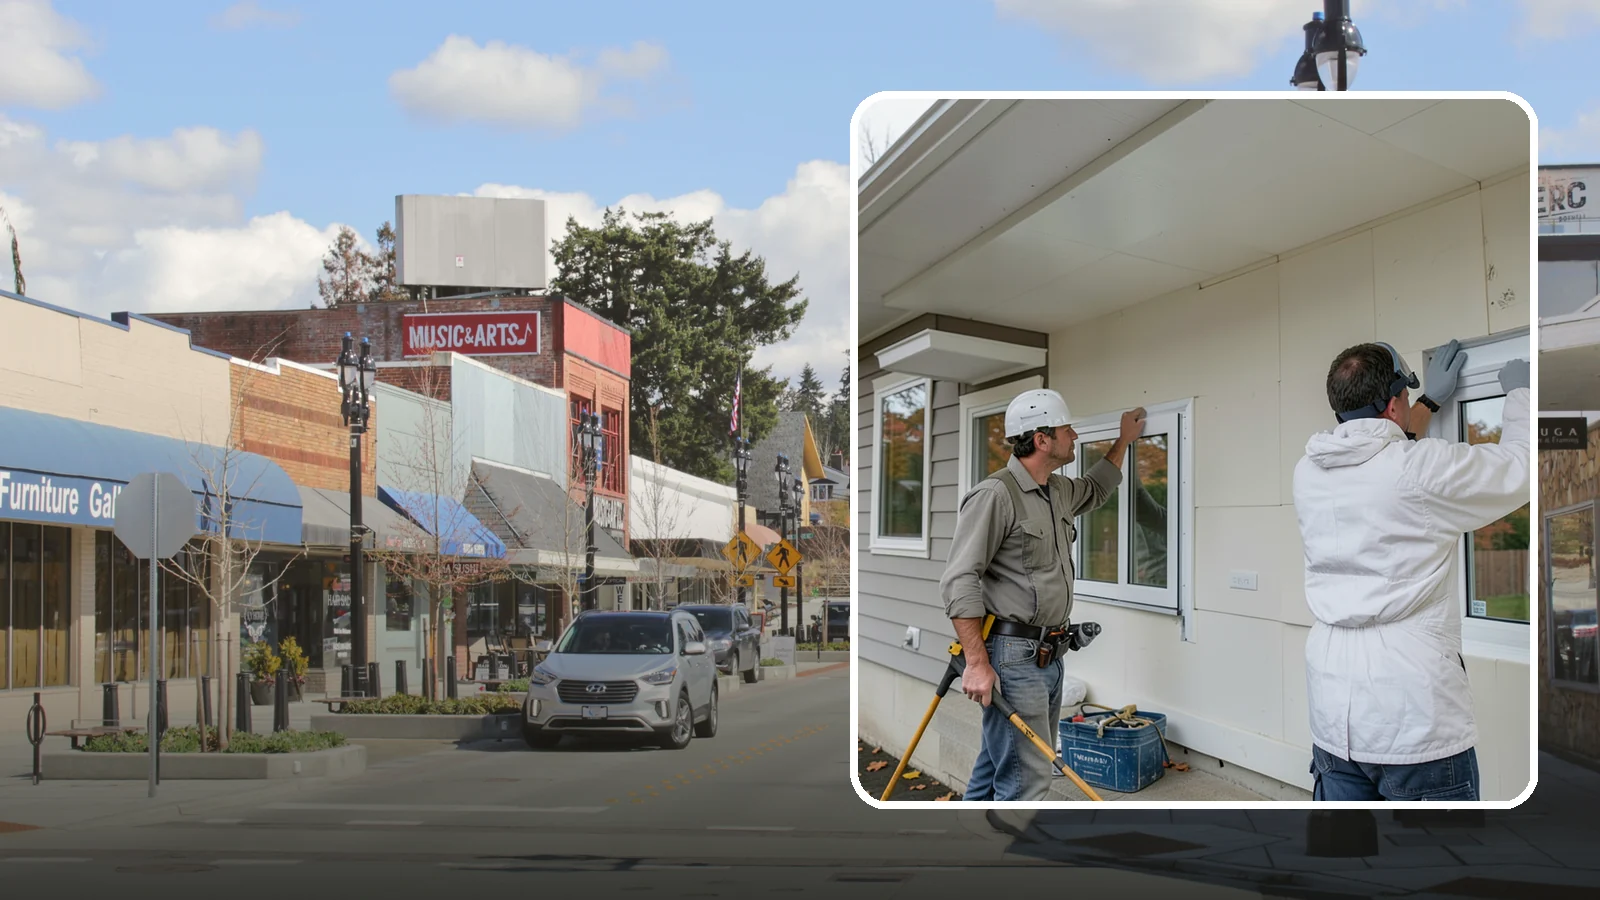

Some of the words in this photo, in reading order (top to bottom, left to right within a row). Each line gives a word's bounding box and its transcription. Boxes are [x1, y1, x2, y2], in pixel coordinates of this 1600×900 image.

[409, 323, 520, 349] MUSIC&ARTS
[0, 471, 79, 515] Furniture
[89, 482, 122, 519] Gal
